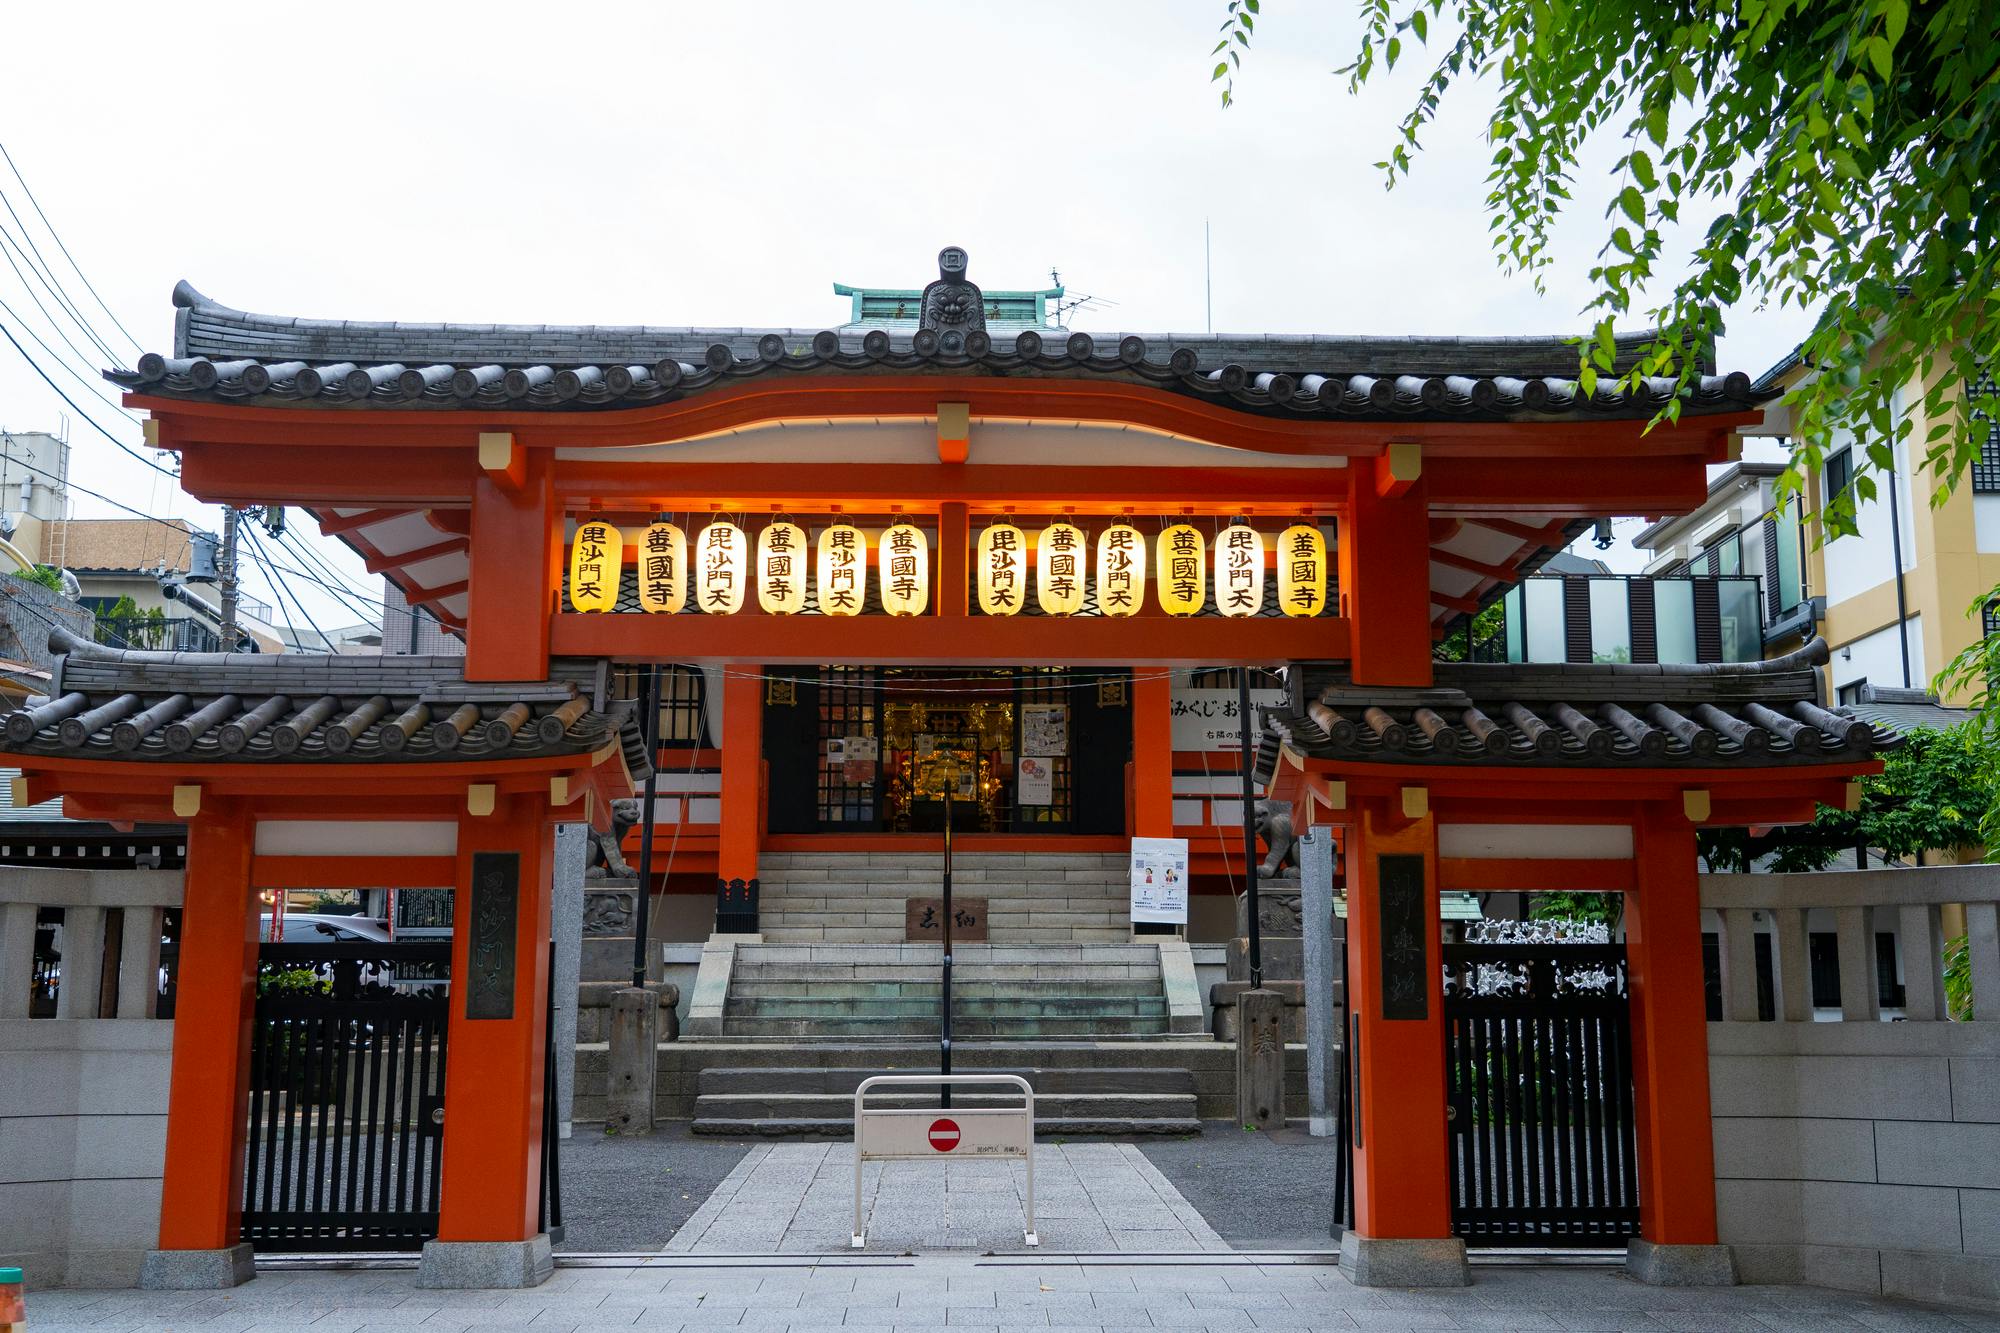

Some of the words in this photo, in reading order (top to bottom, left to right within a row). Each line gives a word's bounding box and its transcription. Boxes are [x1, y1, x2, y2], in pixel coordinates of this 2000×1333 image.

[577, 527, 607, 599] 毘沙門天
[646, 528, 675, 605] 善國寺
[705, 528, 733, 607] 毘沙門天
[766, 527, 793, 601] 善國寺
[829, 531, 856, 609] 毘沙門天
[889, 531, 920, 600] 善國寺
[989, 530, 1017, 607] 毘沙門天
[1048, 527, 1076, 599] 善國寺
[1106, 530, 1133, 607] 毘沙門天
[1170, 530, 1199, 602] 善國寺
[1227, 530, 1254, 609] 毘沙門天
[1290, 533, 1319, 609] 善國寺
